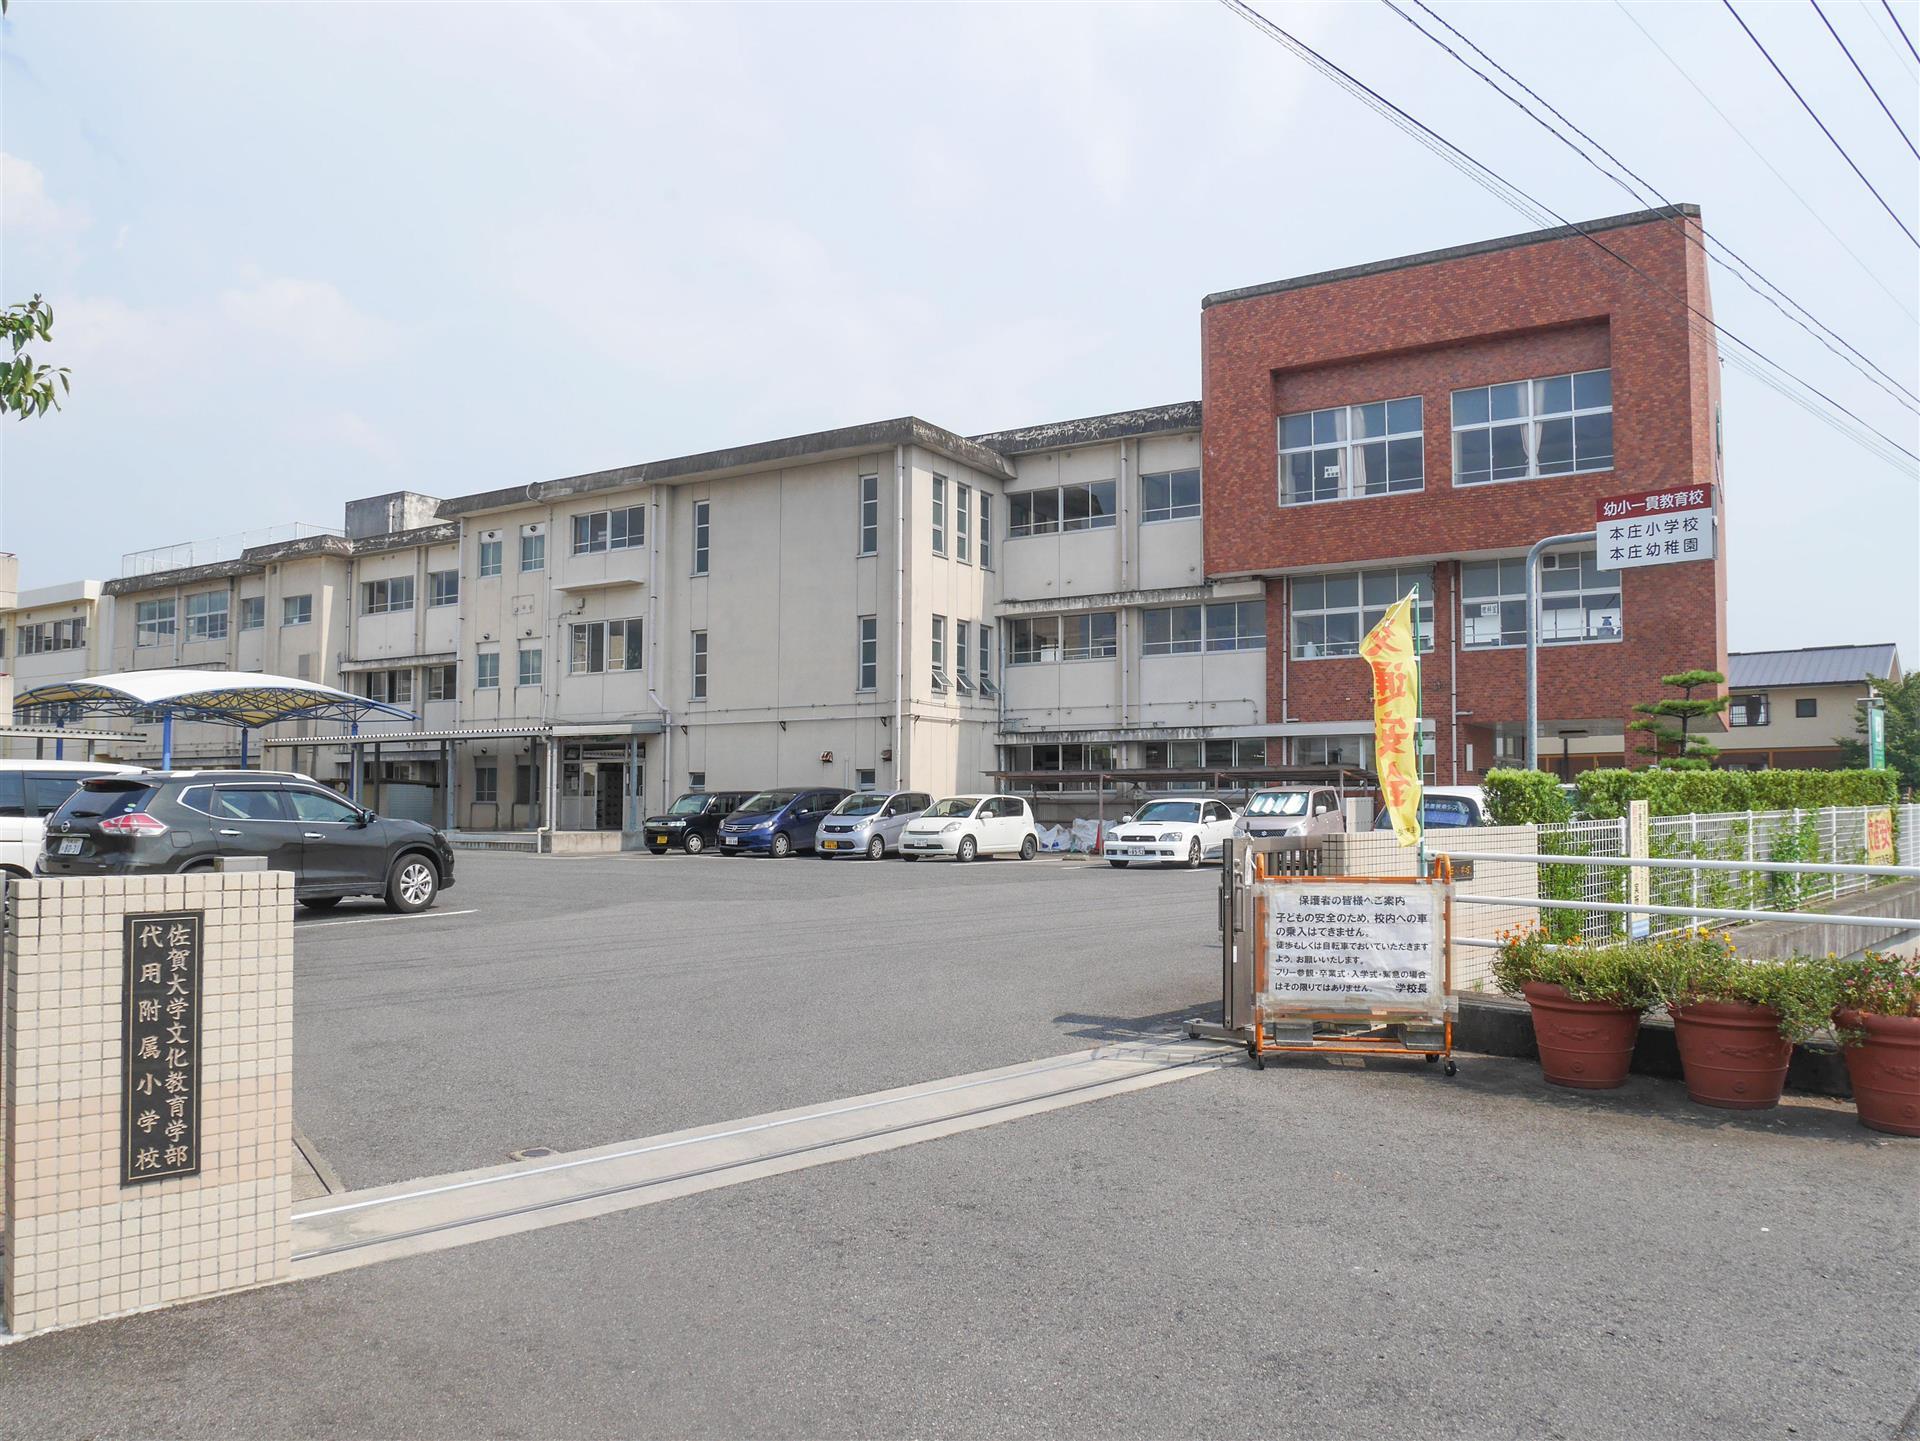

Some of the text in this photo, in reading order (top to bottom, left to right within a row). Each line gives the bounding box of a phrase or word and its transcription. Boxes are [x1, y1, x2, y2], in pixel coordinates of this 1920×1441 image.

[1603, 489, 1705, 517] 幼小一貫教育校
[1609, 517, 1699, 541] 本庄小学校
[1609, 537, 1699, 561] 本庄幼稚園
[1299, 895, 1406, 906] 保護者の皆様へご案内
[1275, 926, 1369, 938] の乗入はできません。
[1395, 982, 1428, 994] 学校長
[134, 923, 164, 1171] 代用附属小学校
[164, 923, 192, 1168] 佐賀大学文化教育学部
